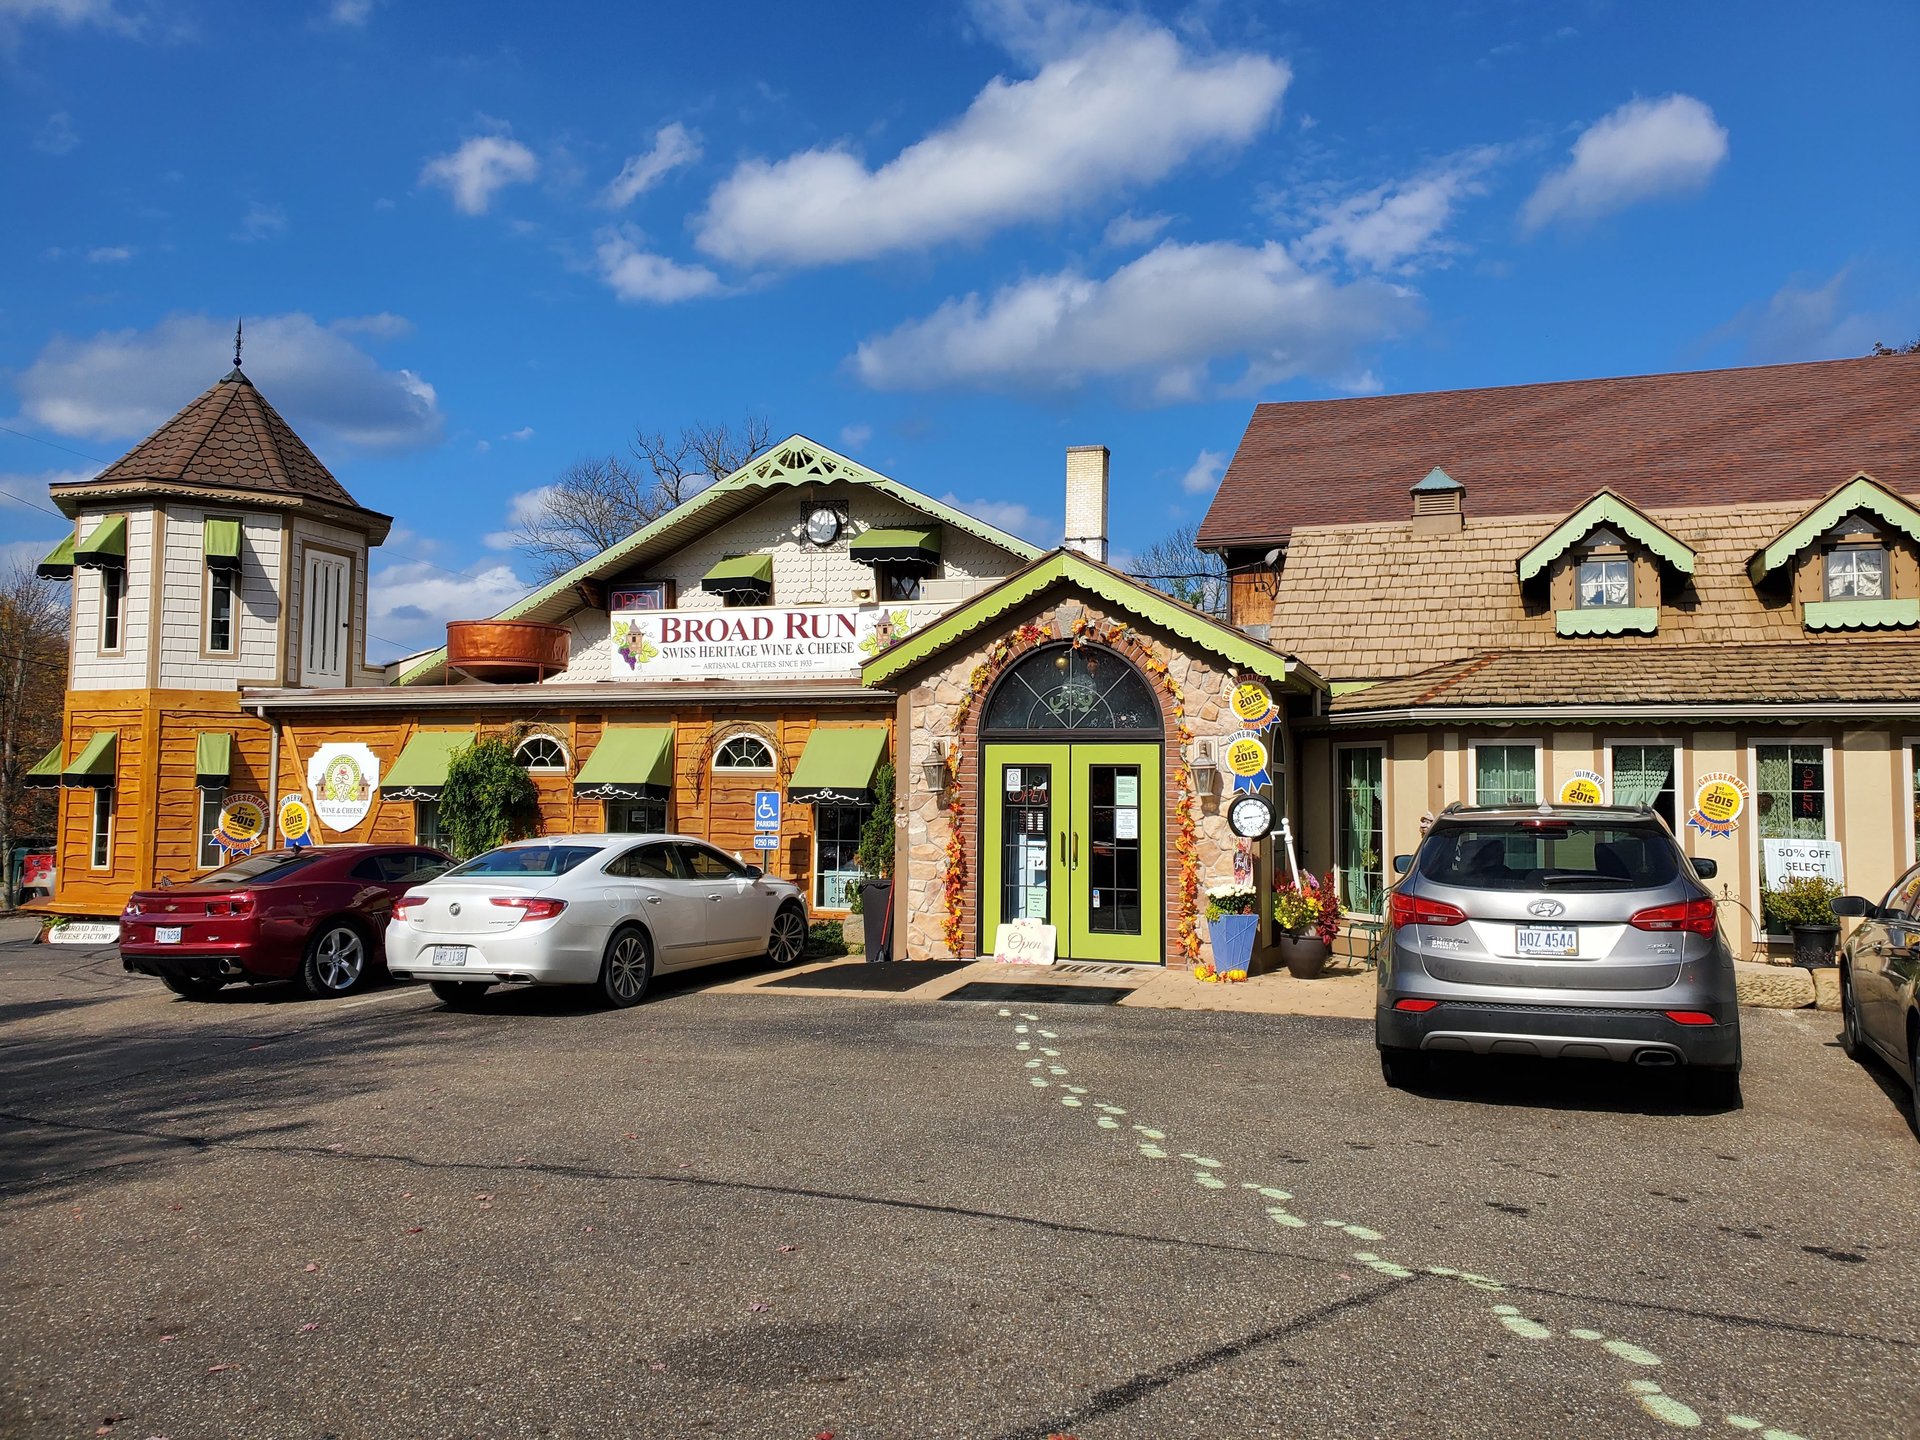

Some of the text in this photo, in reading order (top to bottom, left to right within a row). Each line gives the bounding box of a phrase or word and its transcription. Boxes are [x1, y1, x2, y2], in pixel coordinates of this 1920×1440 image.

[659, 612, 858, 643] BROAD RUN
[662, 641, 854, 659] SWISS HERITAGE WINE & CHEESE
[703, 659, 812, 670] ARTISANAL CRAFTERS SINCE 1933
[1238, 692, 1262, 709] 2015
[1228, 730, 1256, 743] WINERY
[1234, 750, 1259, 763] 2015
[1575, 771, 1604, 785] WINERY
[1698, 773, 1750, 800] CHEESEMAKER
[1803, 769, 1814, 812] OPEN
[281, 794, 303, 806] WINERY
[1010, 789, 1048, 803] OPEN
[1569, 789, 1594, 804] 2015
[1706, 793, 1733, 807] 2015
[223, 794, 269, 818] CHEESEMAKER
[229, 813, 256, 828] 2015
[284, 813, 302, 826] 2015
[1689, 809, 1738, 831] CHEESEHOUSE
[213, 828, 258, 849] CHEESEHOUSE
[756, 839, 778, 847] $250 FINE
[1778, 848, 1831, 859] 50% OFF
[1785, 862, 1826, 872] SELECT
[54, 932, 113, 940] CHEESE FACTORY
[1008, 932, 1041, 953] Open
[1520, 932, 1573, 948] HQZ 4544
